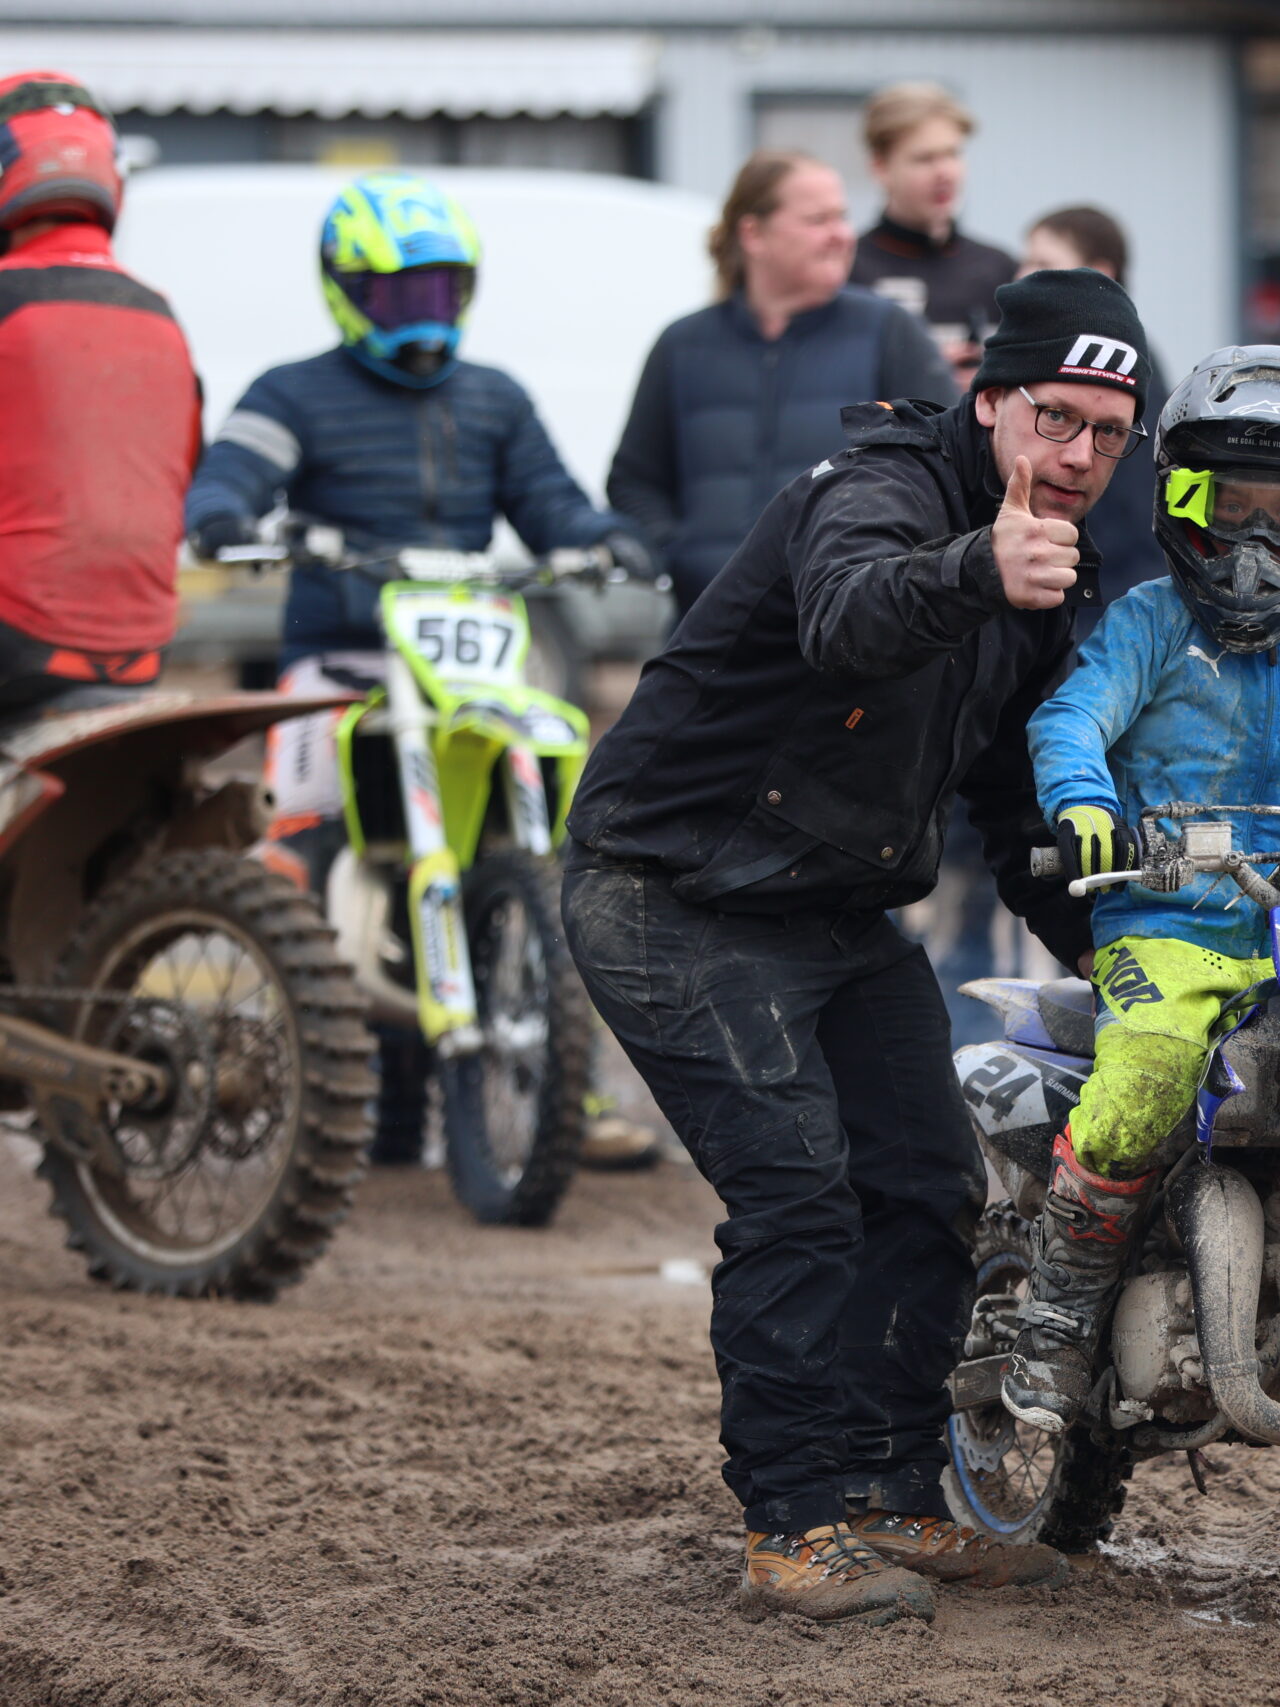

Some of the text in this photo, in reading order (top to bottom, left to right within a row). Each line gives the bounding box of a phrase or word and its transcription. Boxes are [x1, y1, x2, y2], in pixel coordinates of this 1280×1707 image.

[1227, 436, 1239, 444] ONE
[1259, 439, 1271, 447] ONE
[417, 617, 515, 669] 567
[962, 1055, 1041, 1123] 24
